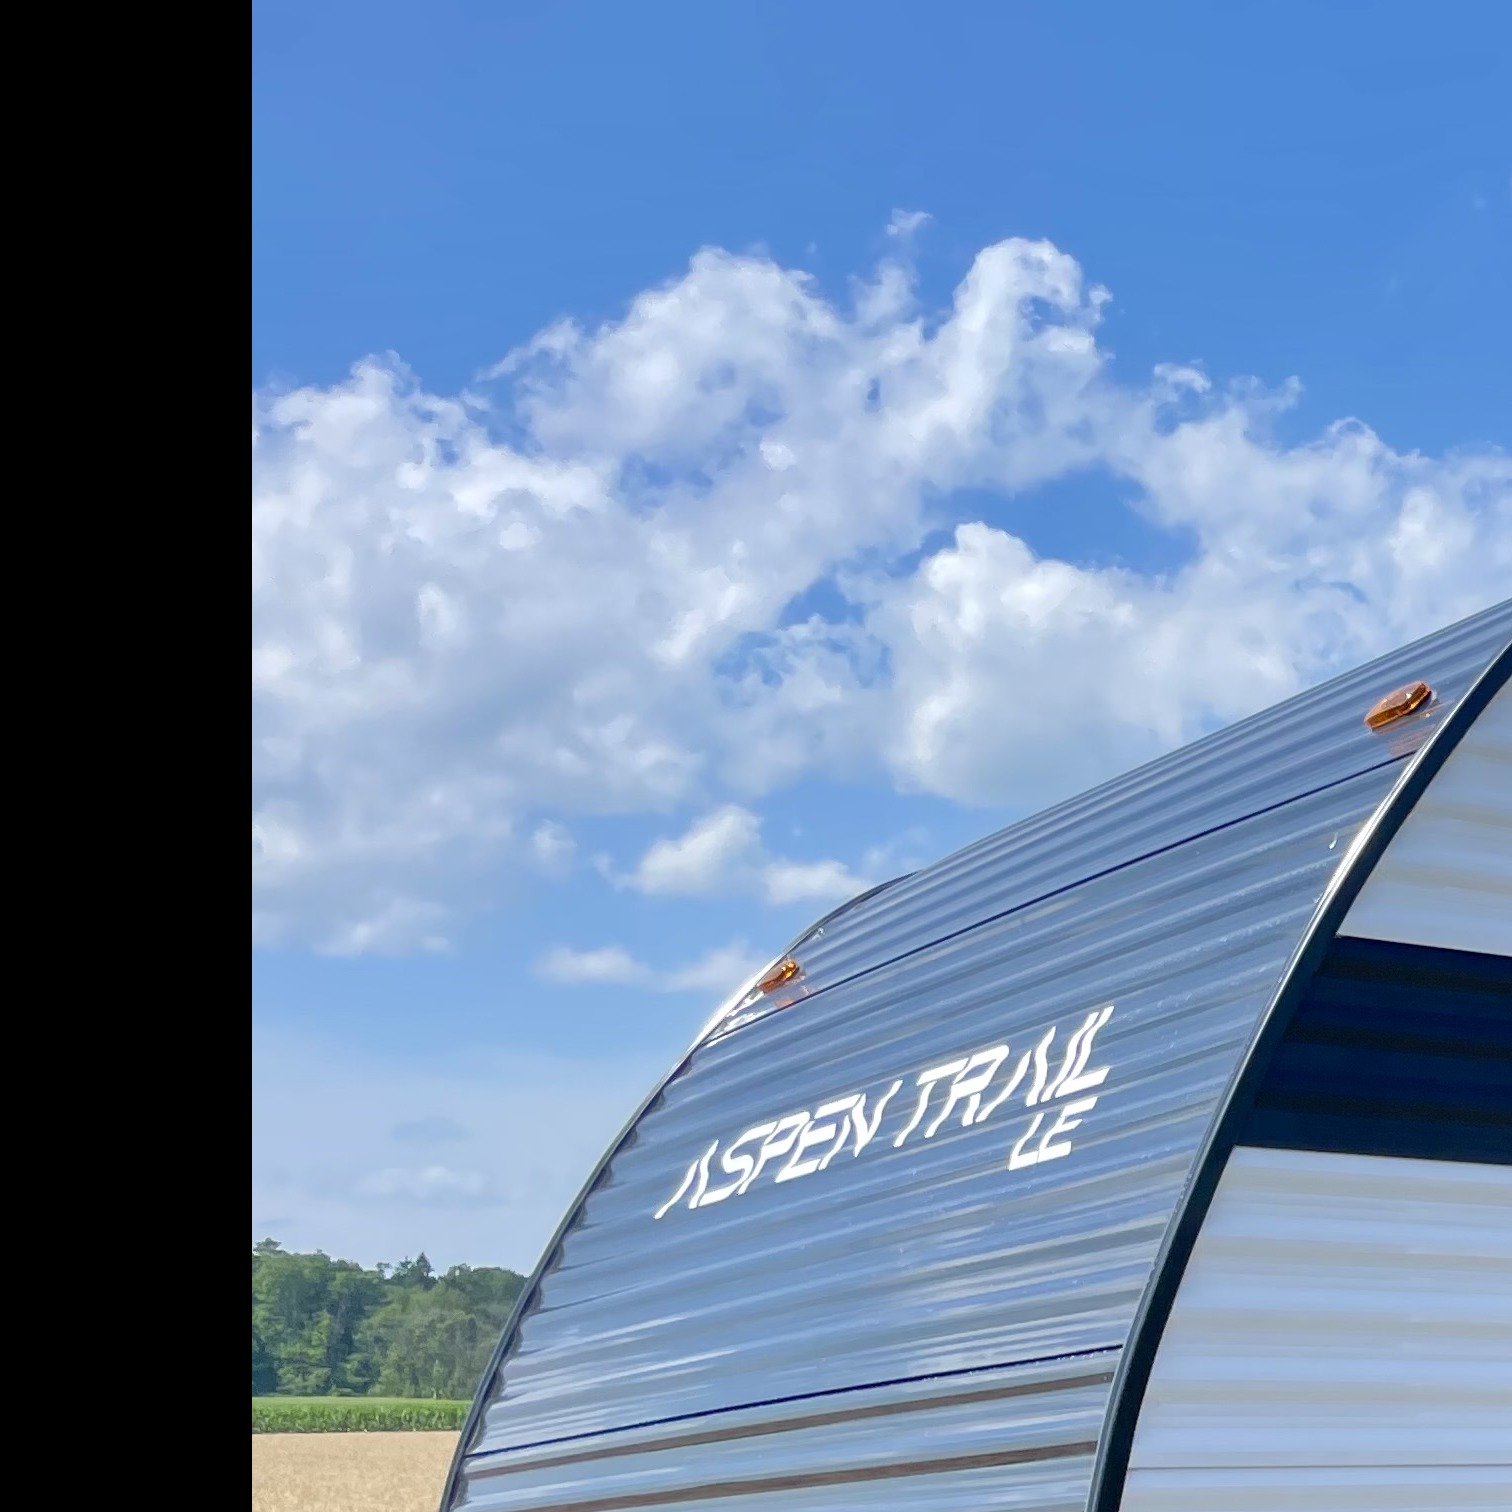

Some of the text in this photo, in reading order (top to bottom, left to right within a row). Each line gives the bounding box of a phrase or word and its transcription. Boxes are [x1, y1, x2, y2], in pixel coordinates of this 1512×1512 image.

[654, 1005, 1115, 1219] ASPEN TRAIL
[1008, 1096, 1097, 1171] LE
